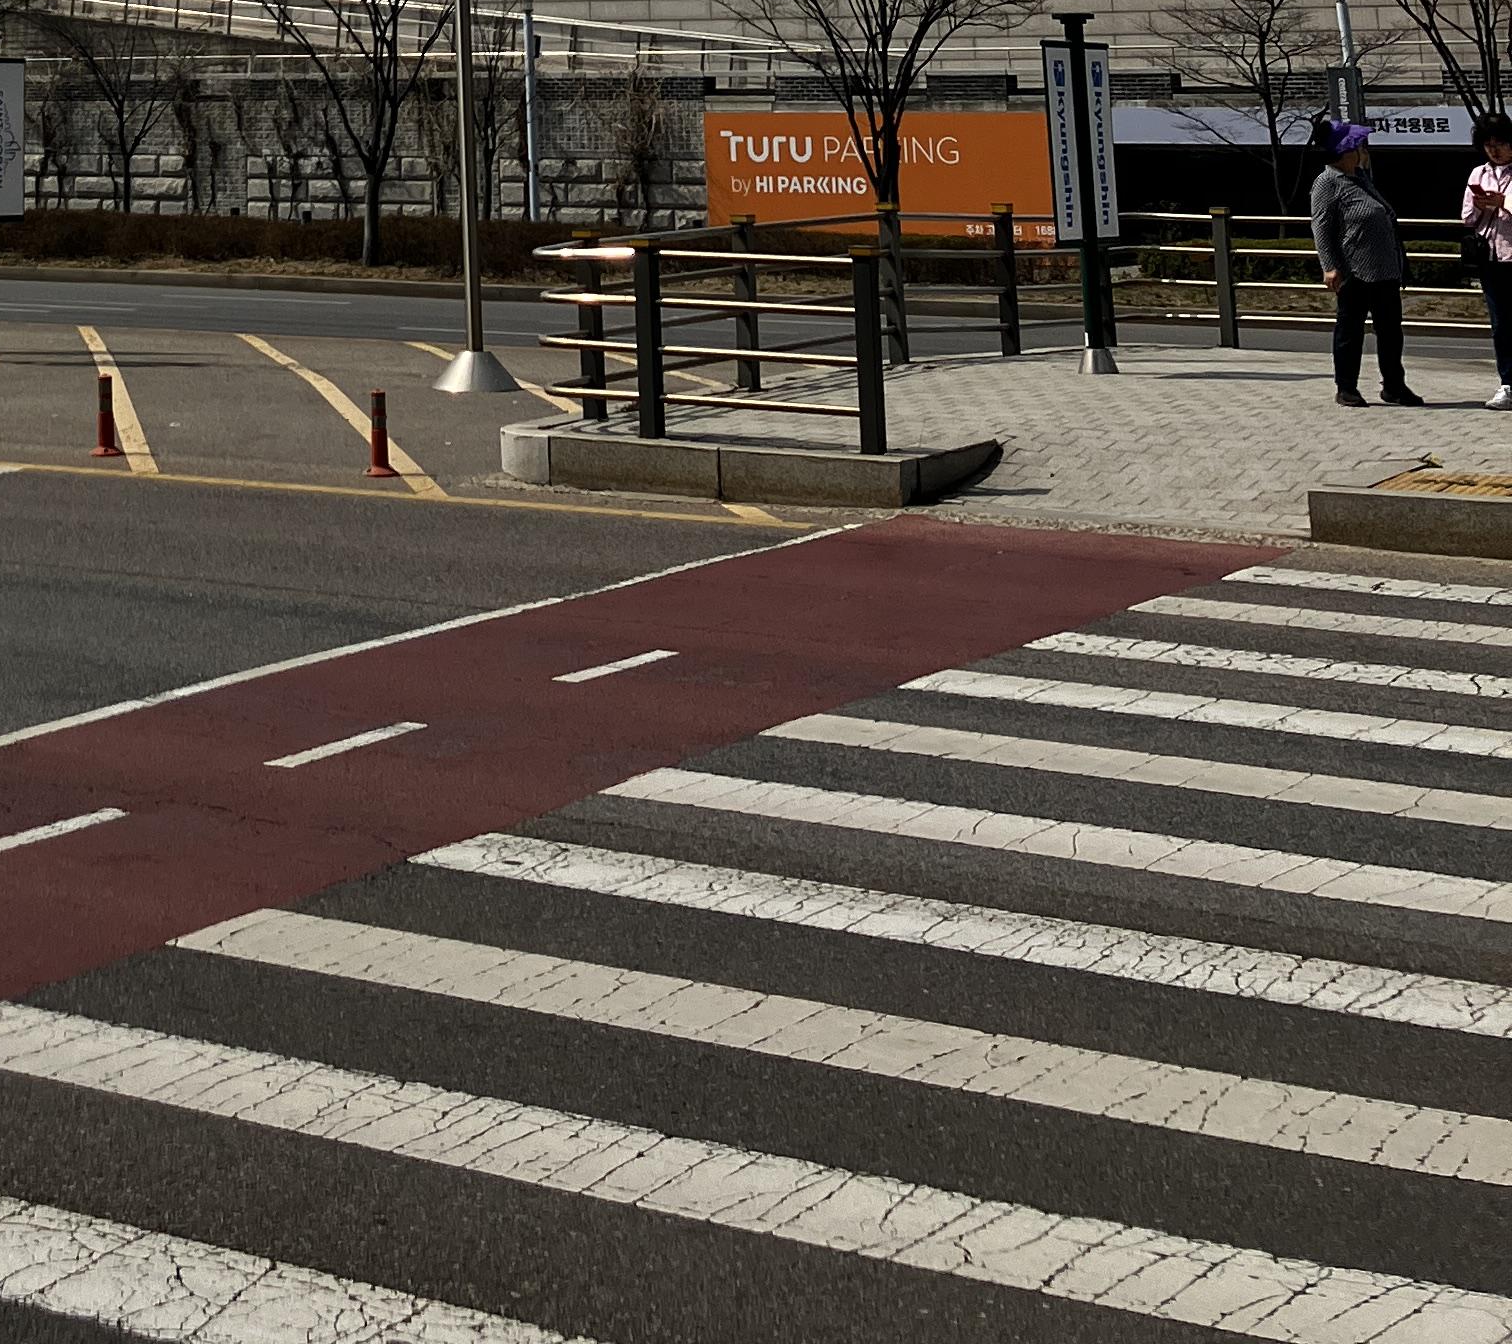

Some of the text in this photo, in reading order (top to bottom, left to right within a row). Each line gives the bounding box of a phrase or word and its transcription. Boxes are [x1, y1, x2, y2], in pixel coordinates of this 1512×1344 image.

[1057, 91, 1073, 228] kyungshin
[1094, 91, 1110, 225] kyungshin
[1394, 117, 1451, 133] 전용통로
[731, 176, 751, 197] by
[755, 176, 774, 193] HI
